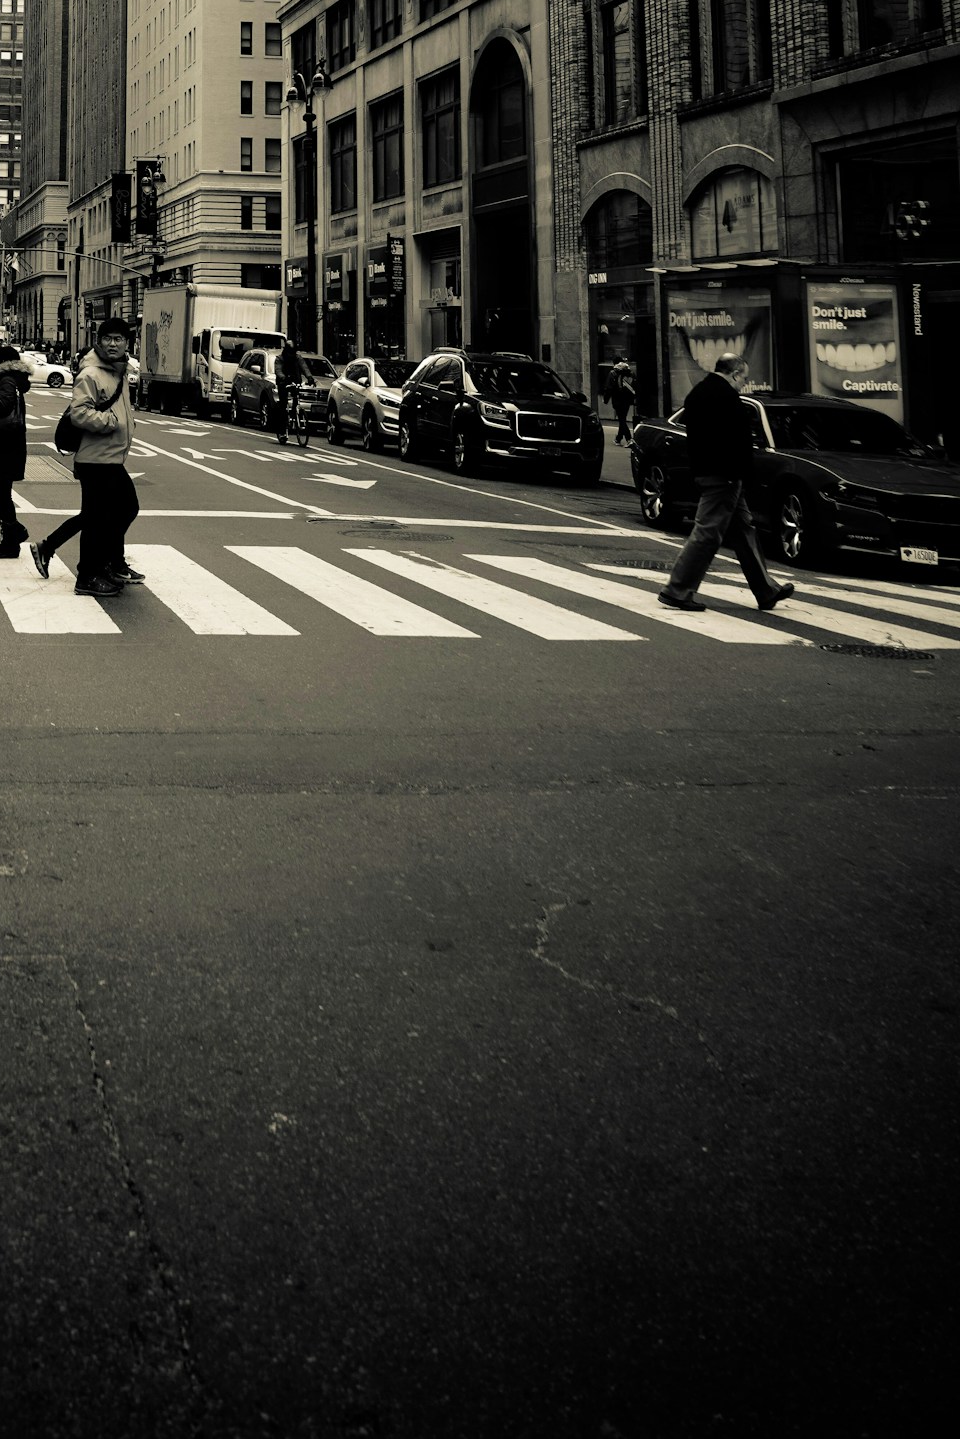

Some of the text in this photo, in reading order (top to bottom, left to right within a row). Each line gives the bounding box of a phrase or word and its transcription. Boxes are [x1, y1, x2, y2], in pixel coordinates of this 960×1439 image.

[293, 268, 303, 279] Bank
[374, 262, 386, 274] Bank
[811, 306, 867, 320] Don't just
[912, 283, 924, 336] Newsstand
[670, 310, 735, 330] Don't just smile.
[812, 318, 847, 330] smile.
[842, 379, 902, 394] Captivate.
